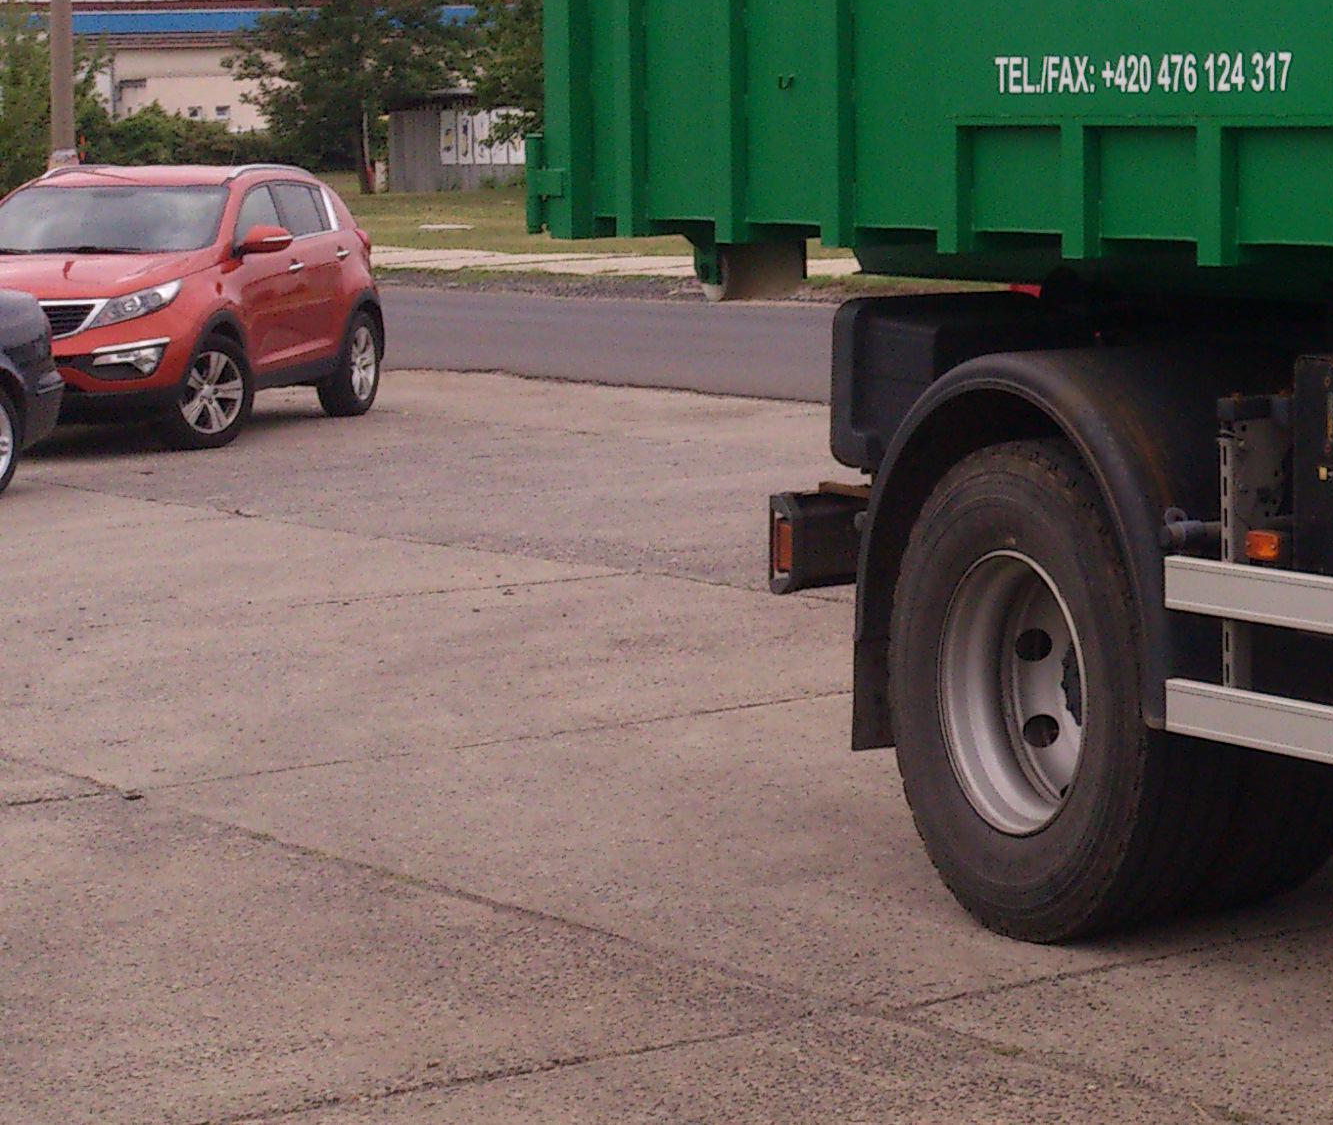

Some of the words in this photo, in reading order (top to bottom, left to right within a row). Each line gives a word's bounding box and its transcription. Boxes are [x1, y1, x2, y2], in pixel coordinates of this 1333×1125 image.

[995, 56, 1095, 94] TEL./FAX:
[1101, 54, 1151, 93] +420
[1157, 53, 1197, 92] 476
[1204, 52, 1245, 92] 124
[1251, 52, 1292, 91] 317
